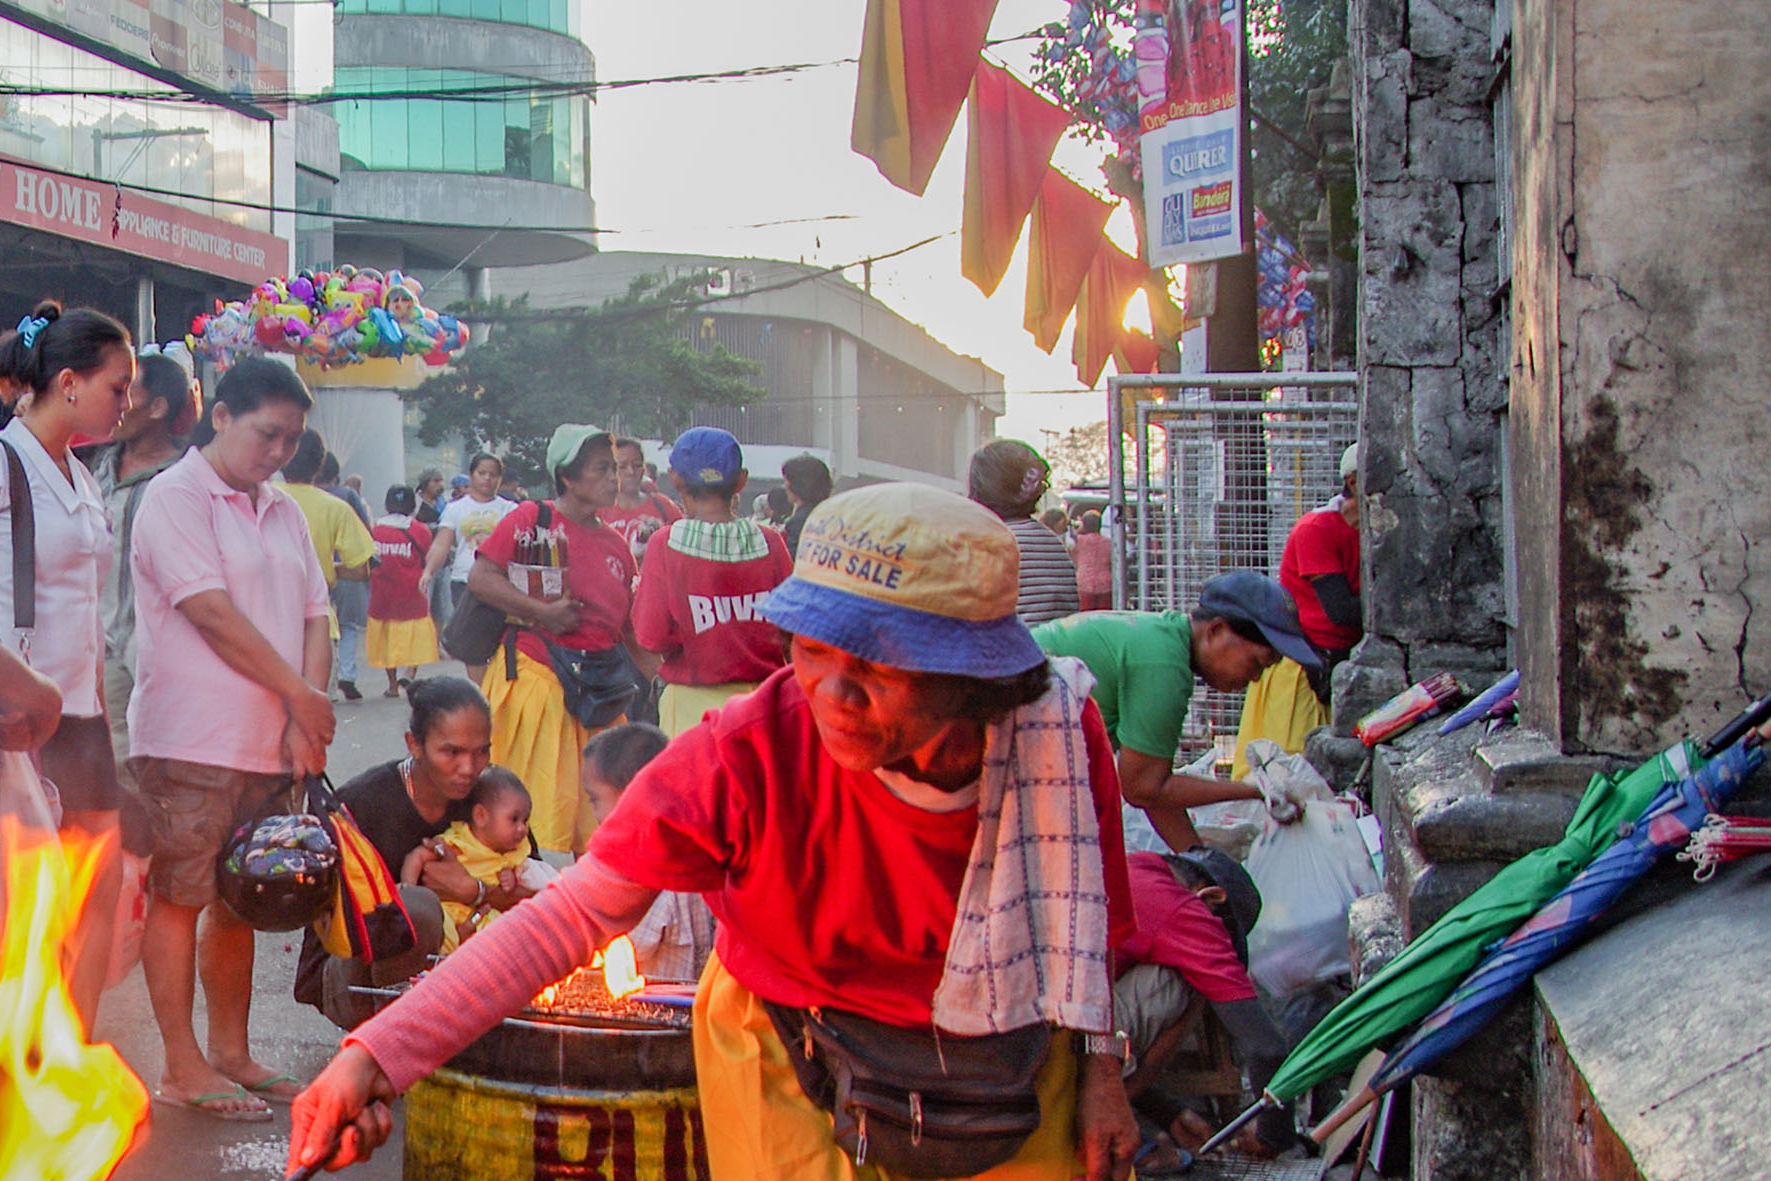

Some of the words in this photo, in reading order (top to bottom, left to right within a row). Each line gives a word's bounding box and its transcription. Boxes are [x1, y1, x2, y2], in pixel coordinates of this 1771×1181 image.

[110, 14, 149, 41] FEDDERS
[14, 167, 102, 232] HOME
[116, 207, 170, 242] APPLIANCE
[171, 223, 179, 245] &
[180, 226, 232, 260] FURNITURE
[233, 241, 266, 270] CENTER
[810, 543, 842, 571] FOR
[845, 554, 903, 590] SALE
